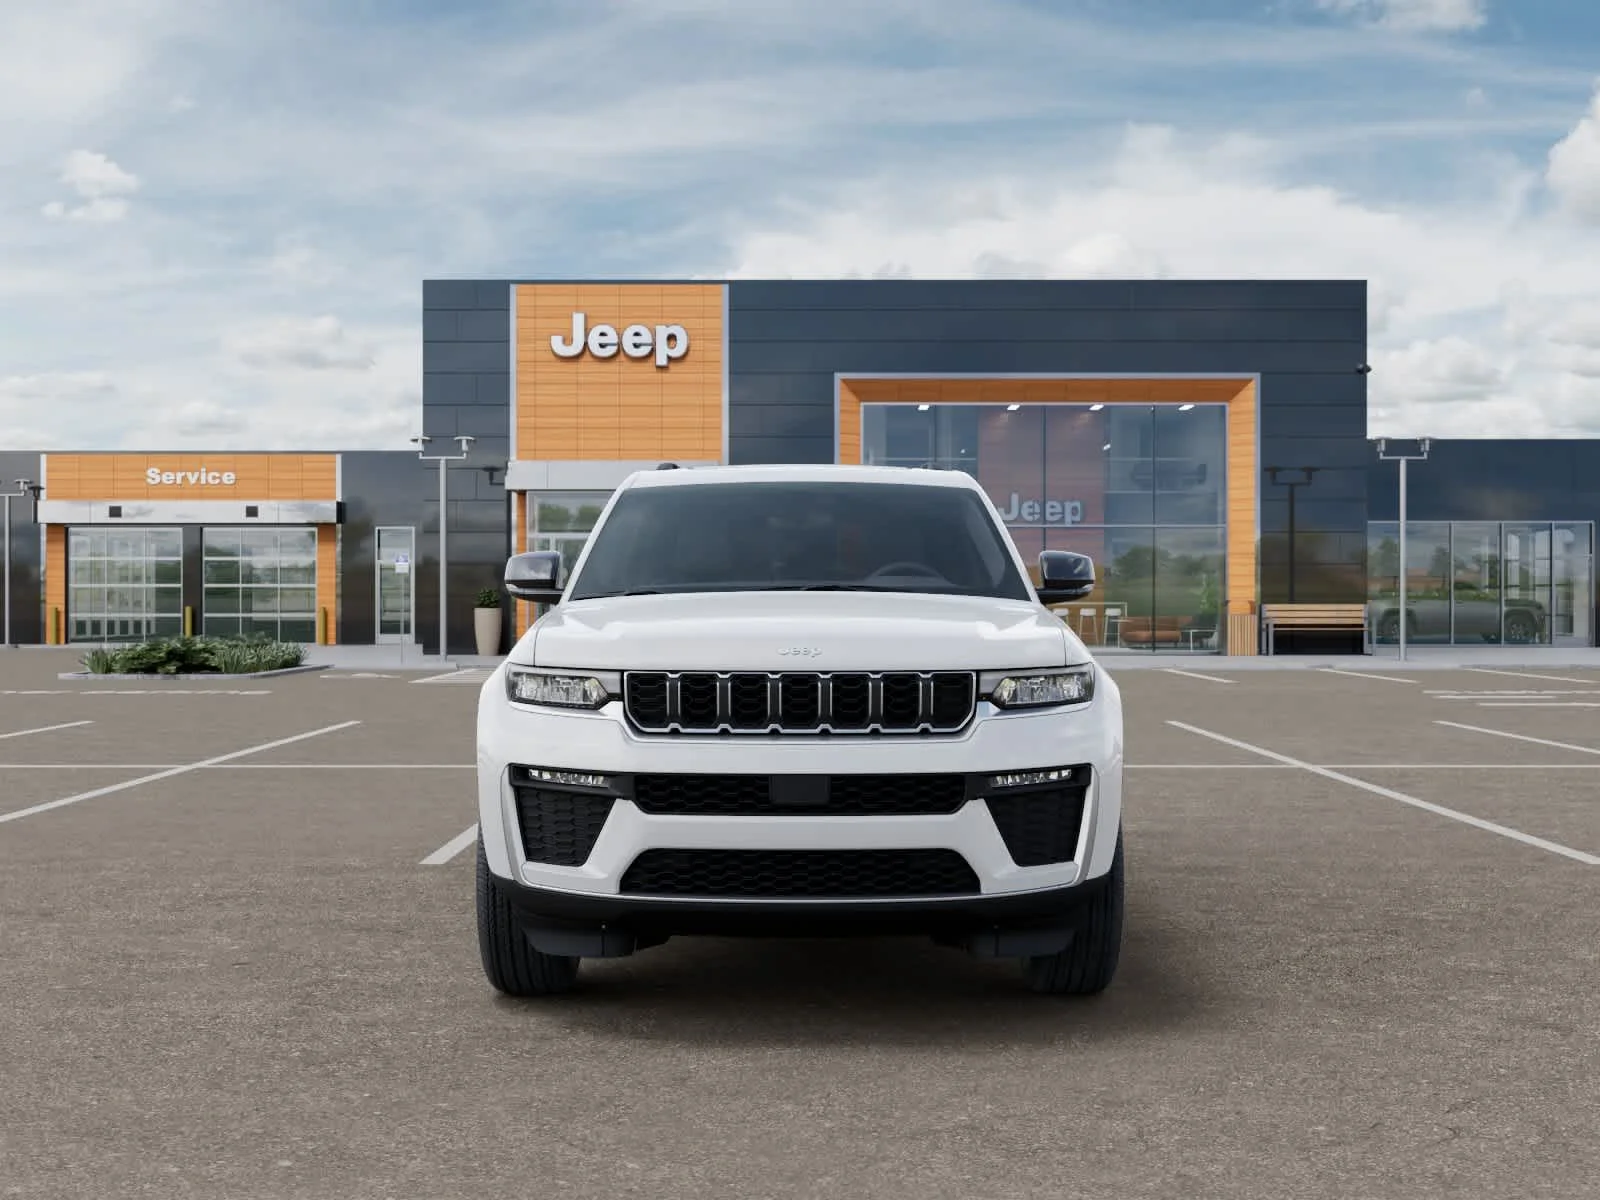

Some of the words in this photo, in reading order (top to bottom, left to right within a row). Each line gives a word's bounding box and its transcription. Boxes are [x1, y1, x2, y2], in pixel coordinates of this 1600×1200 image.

[550, 312, 689, 367] Jeep
[146, 467, 236, 485] Service
[999, 492, 1082, 525] Jeep
